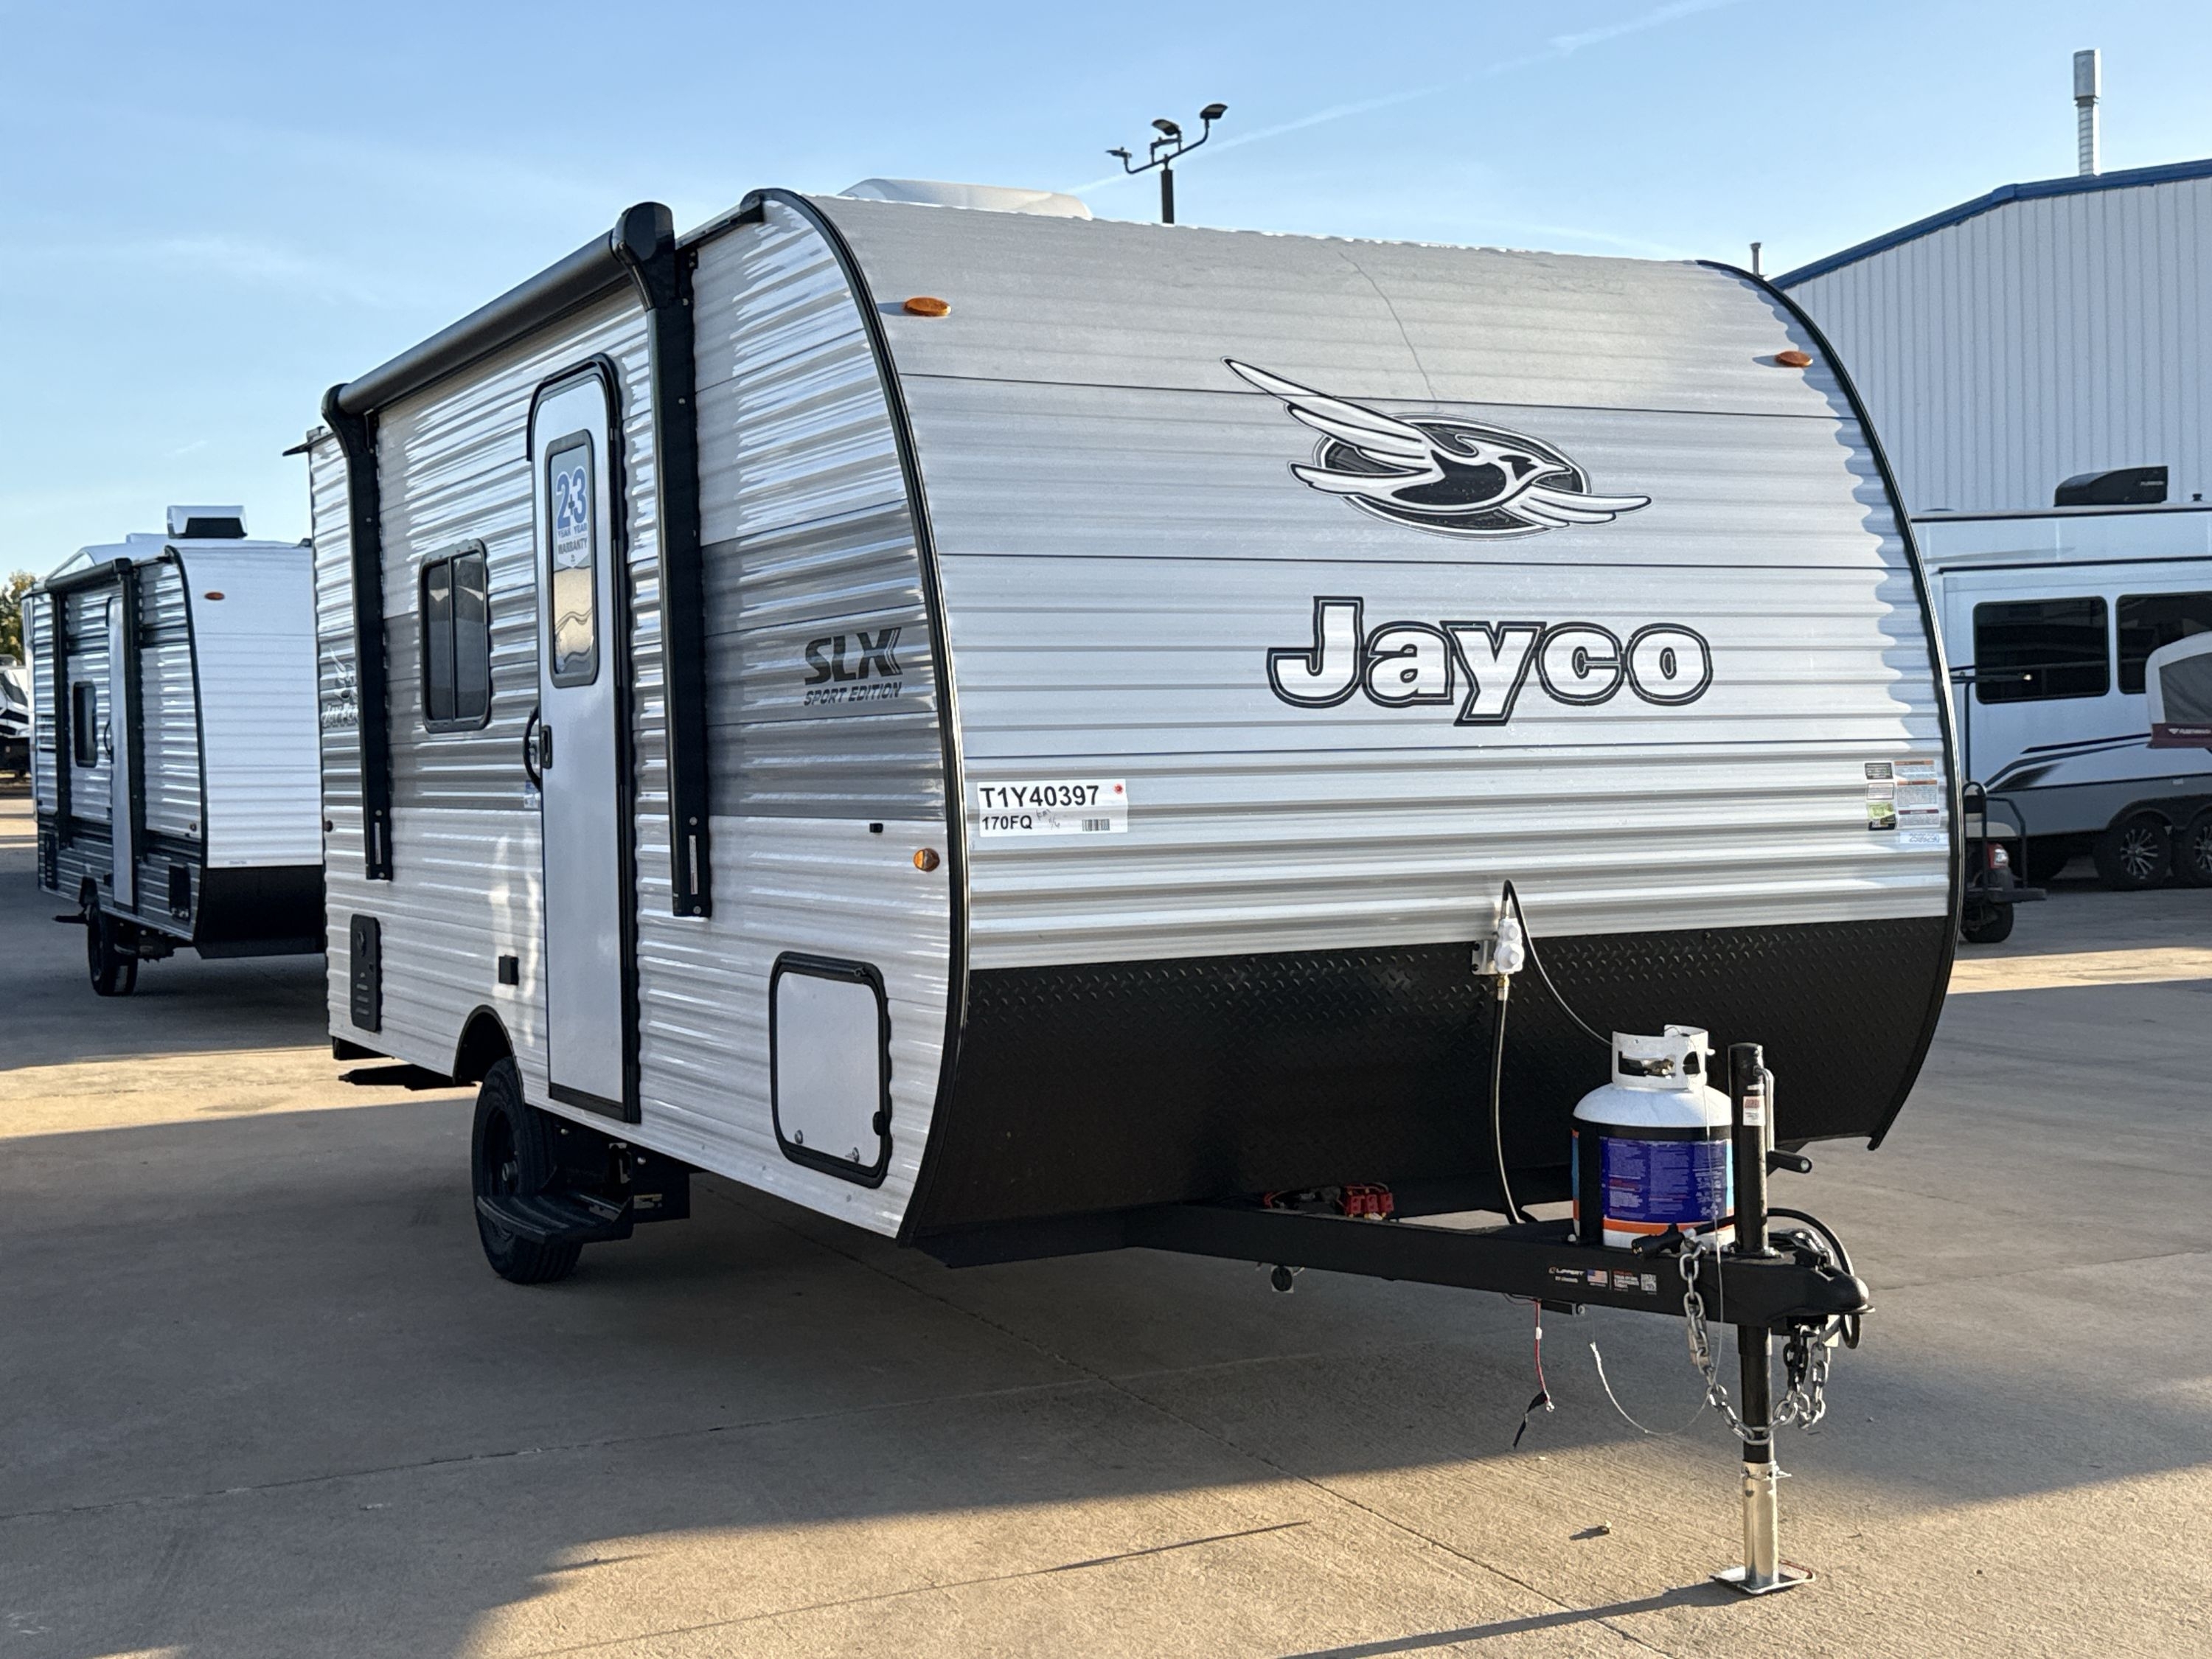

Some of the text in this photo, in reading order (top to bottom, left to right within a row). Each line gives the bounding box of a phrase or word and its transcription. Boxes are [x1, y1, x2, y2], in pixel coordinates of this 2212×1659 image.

[558, 538, 588, 554] WARRANTY
[804, 627, 902, 685] SLX
[1267, 596, 1714, 726] Jayco
[804, 681, 902, 706] SPORT EDITION
[980, 785, 1099, 808] T1Y40397
[982, 815, 1032, 830] 170FQ
